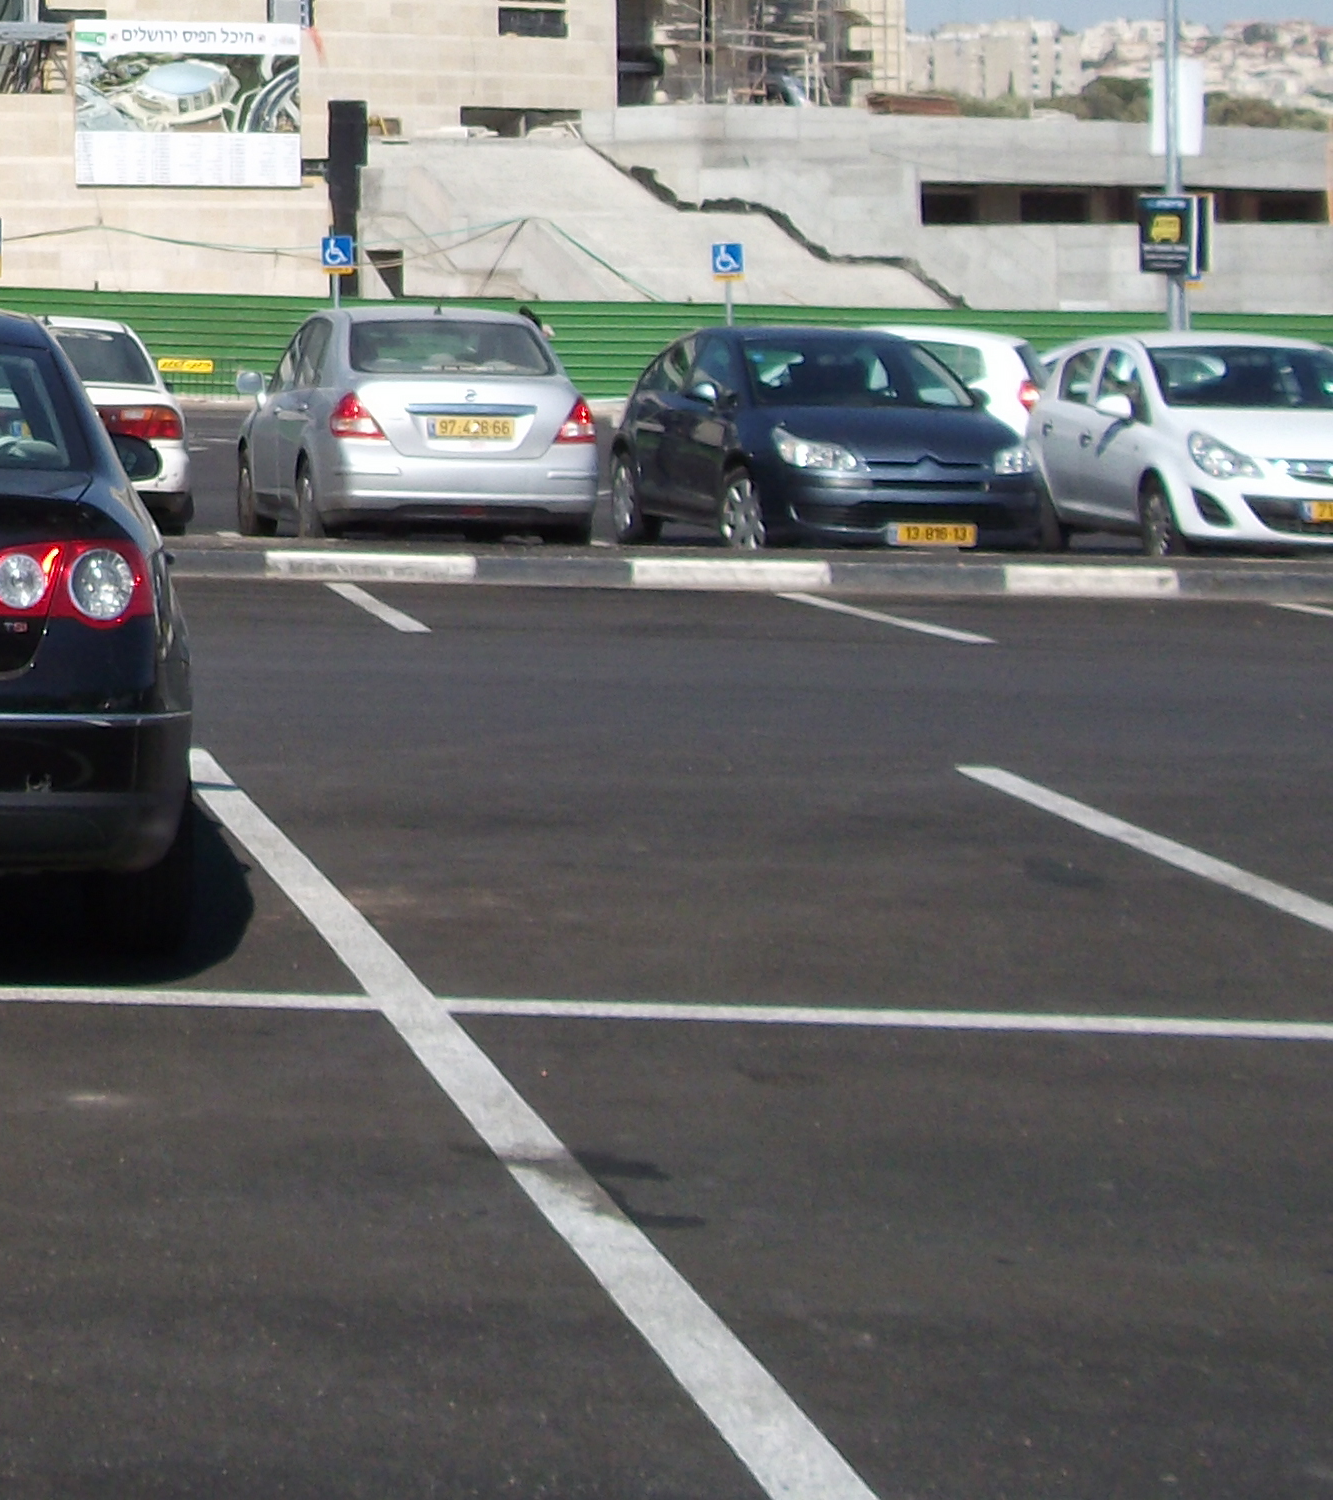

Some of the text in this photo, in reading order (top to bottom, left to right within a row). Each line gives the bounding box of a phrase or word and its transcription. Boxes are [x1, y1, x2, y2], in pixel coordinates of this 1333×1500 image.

[121, 26, 178, 43] ירושלים
[181, 28, 217, 44] הפיס
[220, 27, 254, 44] היכל
